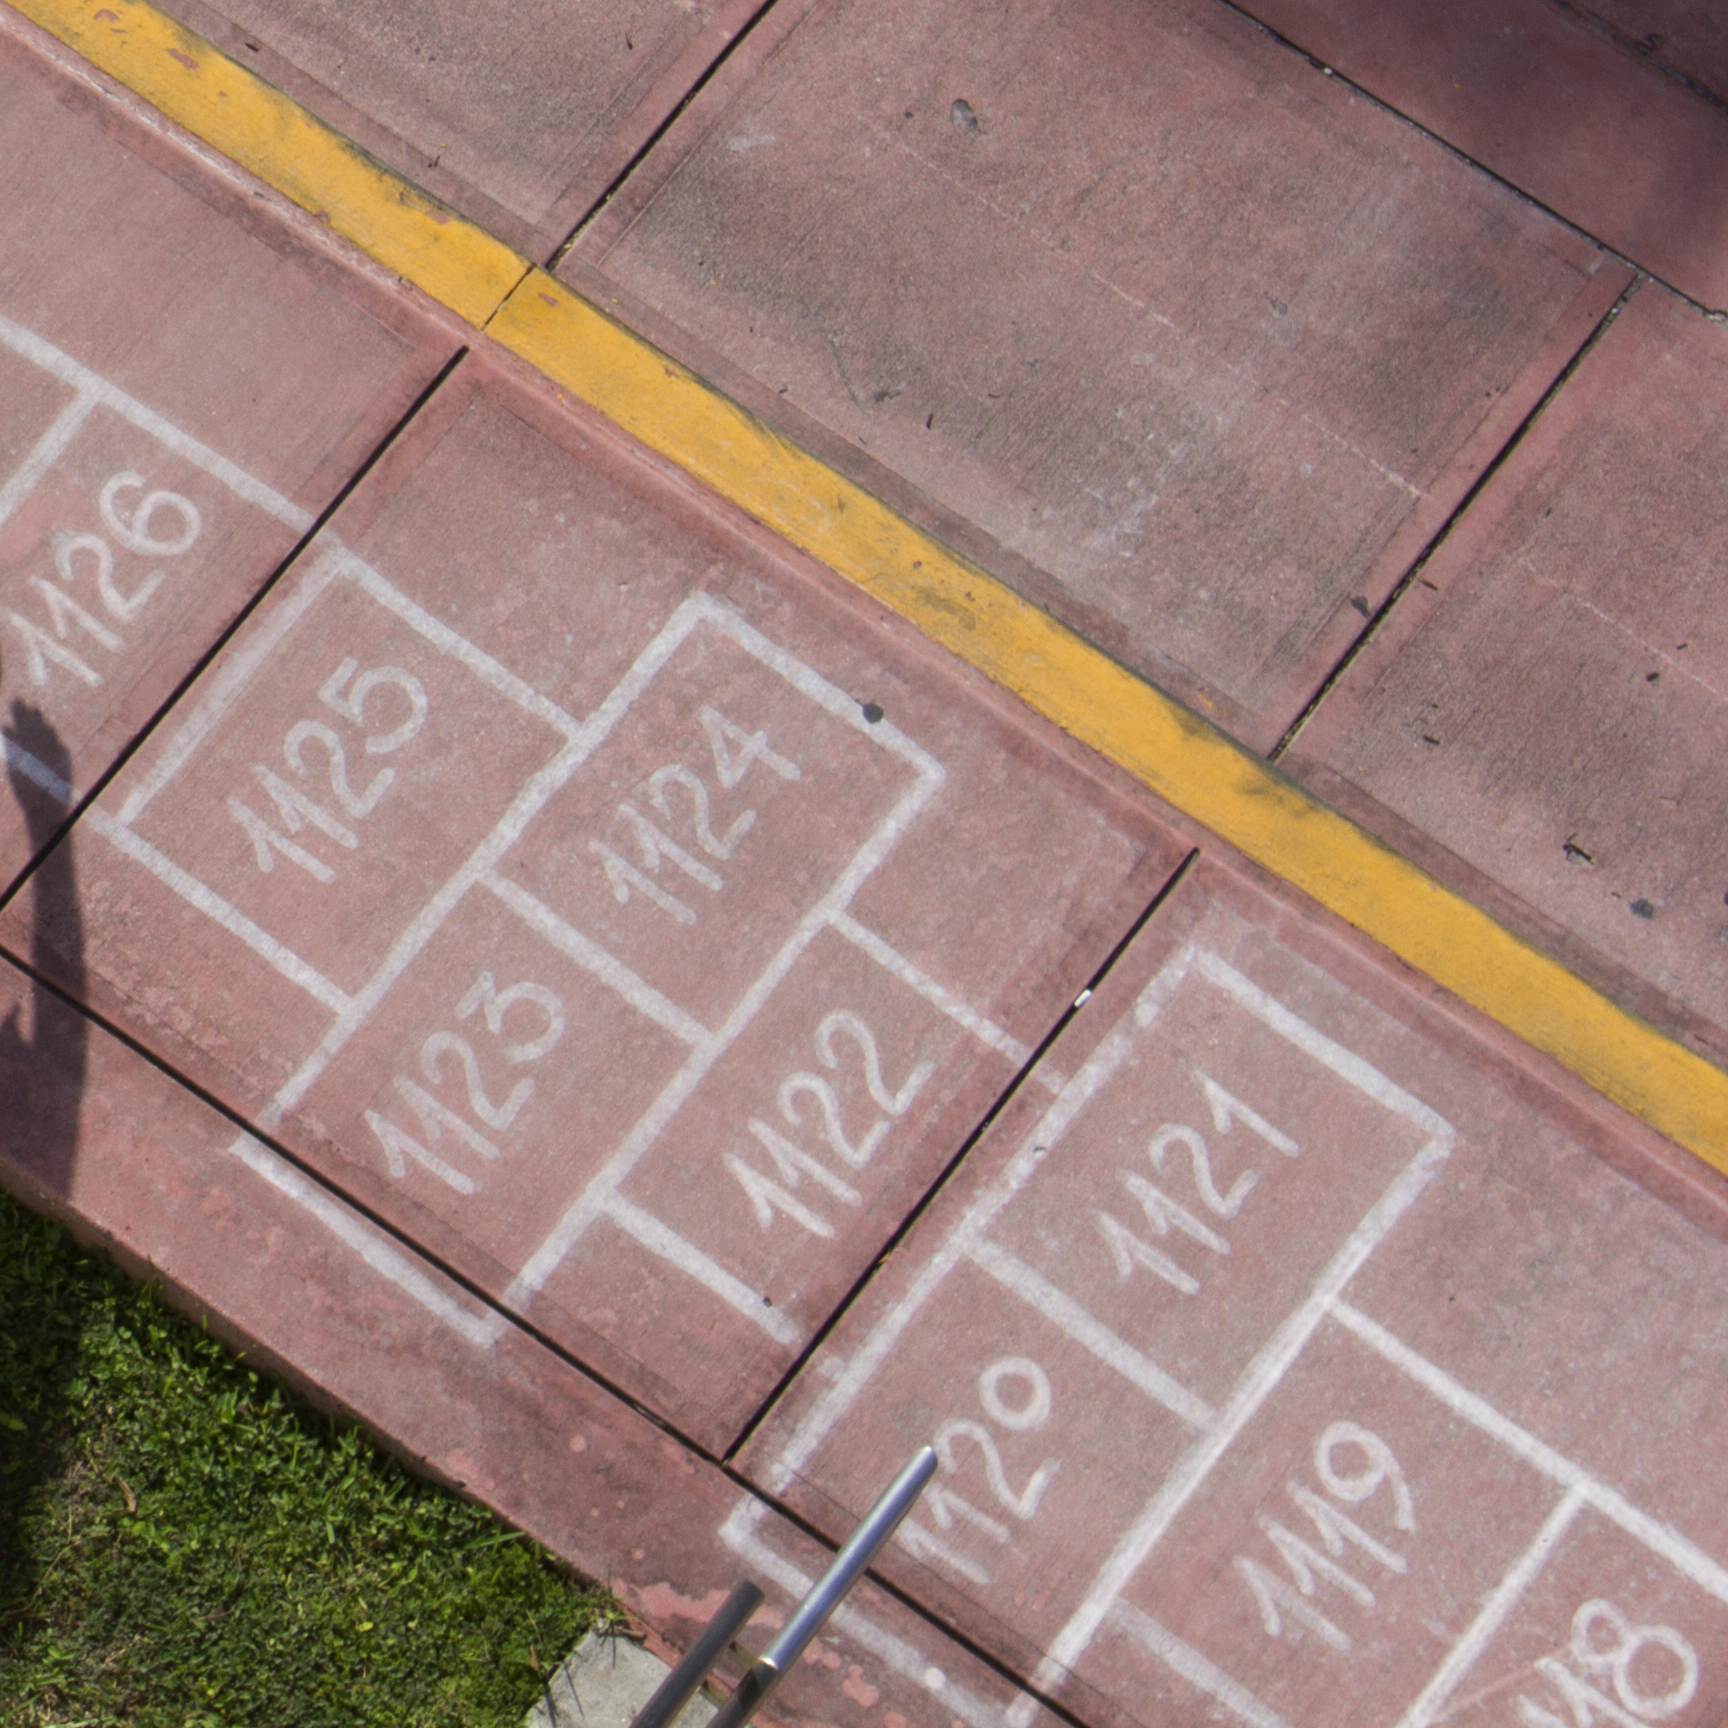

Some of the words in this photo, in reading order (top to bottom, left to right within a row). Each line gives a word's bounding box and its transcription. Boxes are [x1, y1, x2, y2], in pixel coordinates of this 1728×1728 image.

[7, 473, 202, 687] 1126
[228, 659, 428, 884] 1125
[591, 705, 800, 925] 1124
[364, 971, 564, 1195] 1123
[724, 1010, 935, 1239] 1122
[1097, 1073, 1299, 1295] 1121
[1236, 1421, 1414, 1651] 1119
